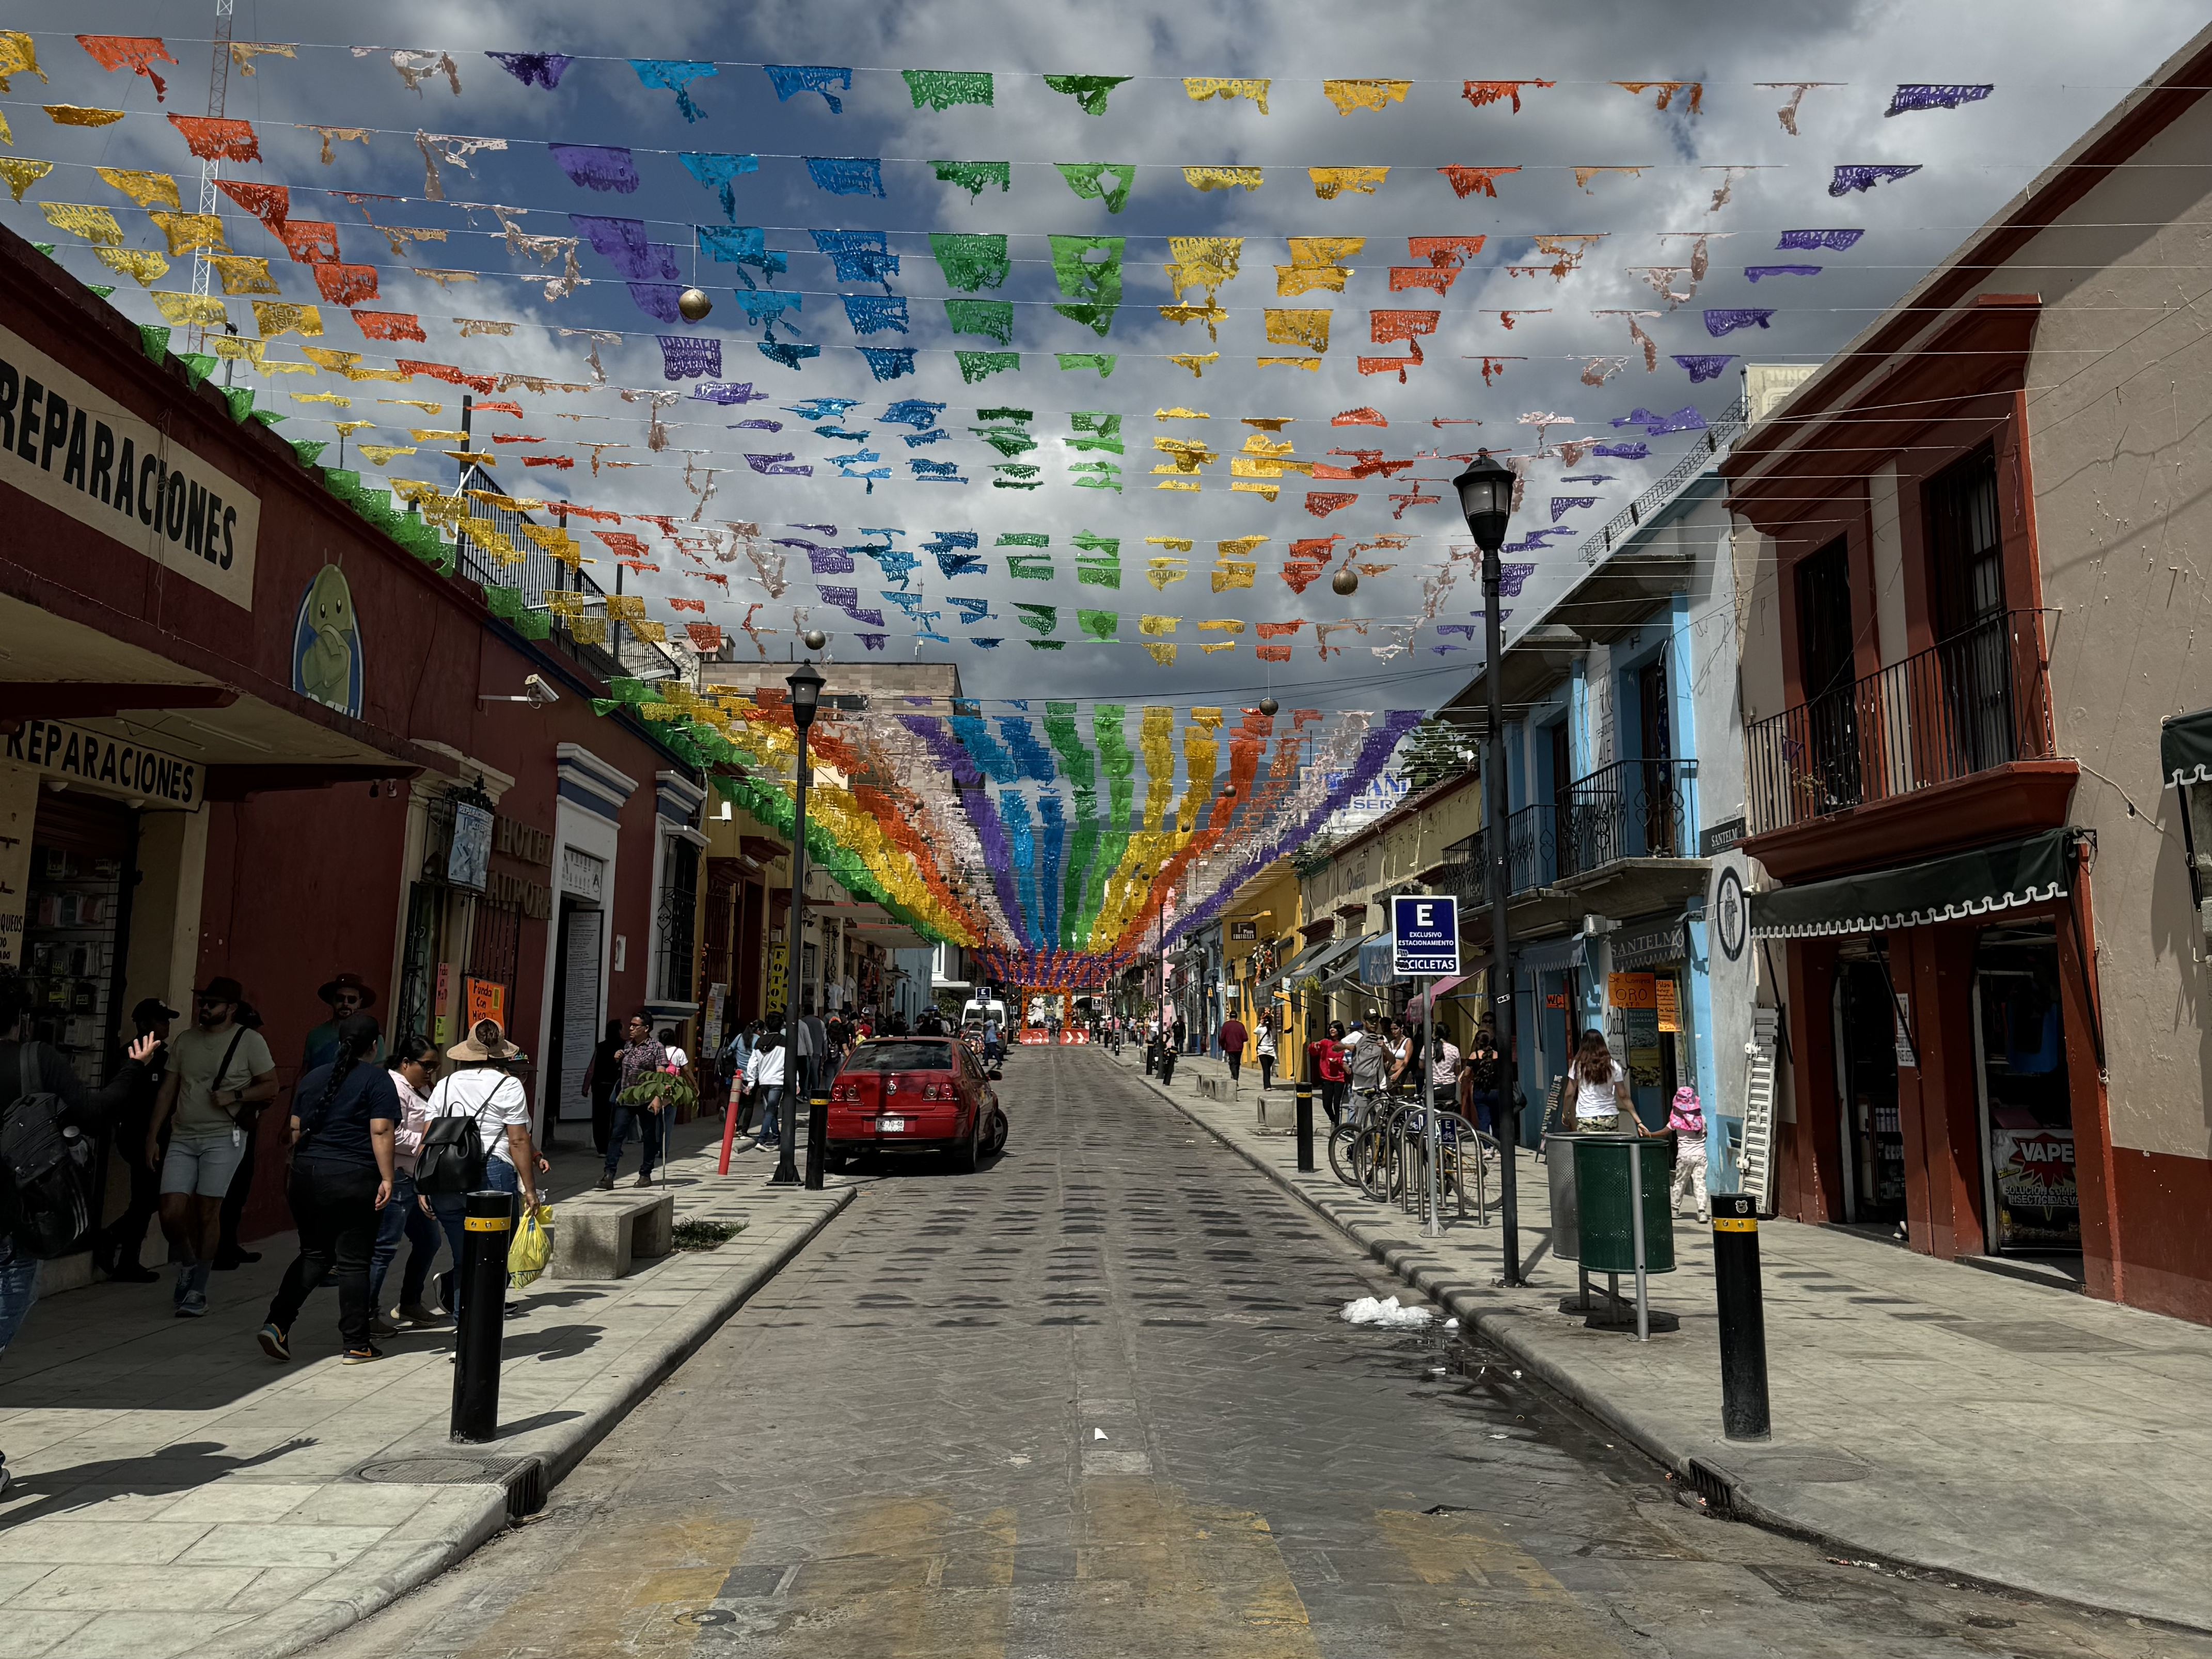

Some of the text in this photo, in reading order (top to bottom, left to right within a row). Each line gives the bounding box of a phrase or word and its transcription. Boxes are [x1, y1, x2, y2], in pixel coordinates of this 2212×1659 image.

[0, 358, 236, 570] REPARACIONES
[7, 720, 194, 802] REPARACIONES
[1353, 799, 1397, 810] SER
[0, 913, 23, 934] QUEOS
[1417, 905, 1433, 926] E
[1611, 927, 1684, 956] SANTELMO
[1396, 959, 1455, 970] CICLETAS
[769, 951, 784, 1009] FOTOS
[1608, 973, 1620, 983] Se
[473, 979, 492, 997] Funda
[1616, 988, 1648, 1001] ORO
[476, 997, 486, 1008] Con
[1445, 1120, 1451, 1129] E
[2019, 1142, 2075, 1162] VAPE
[2048, 1188, 2077, 1196] COMP
